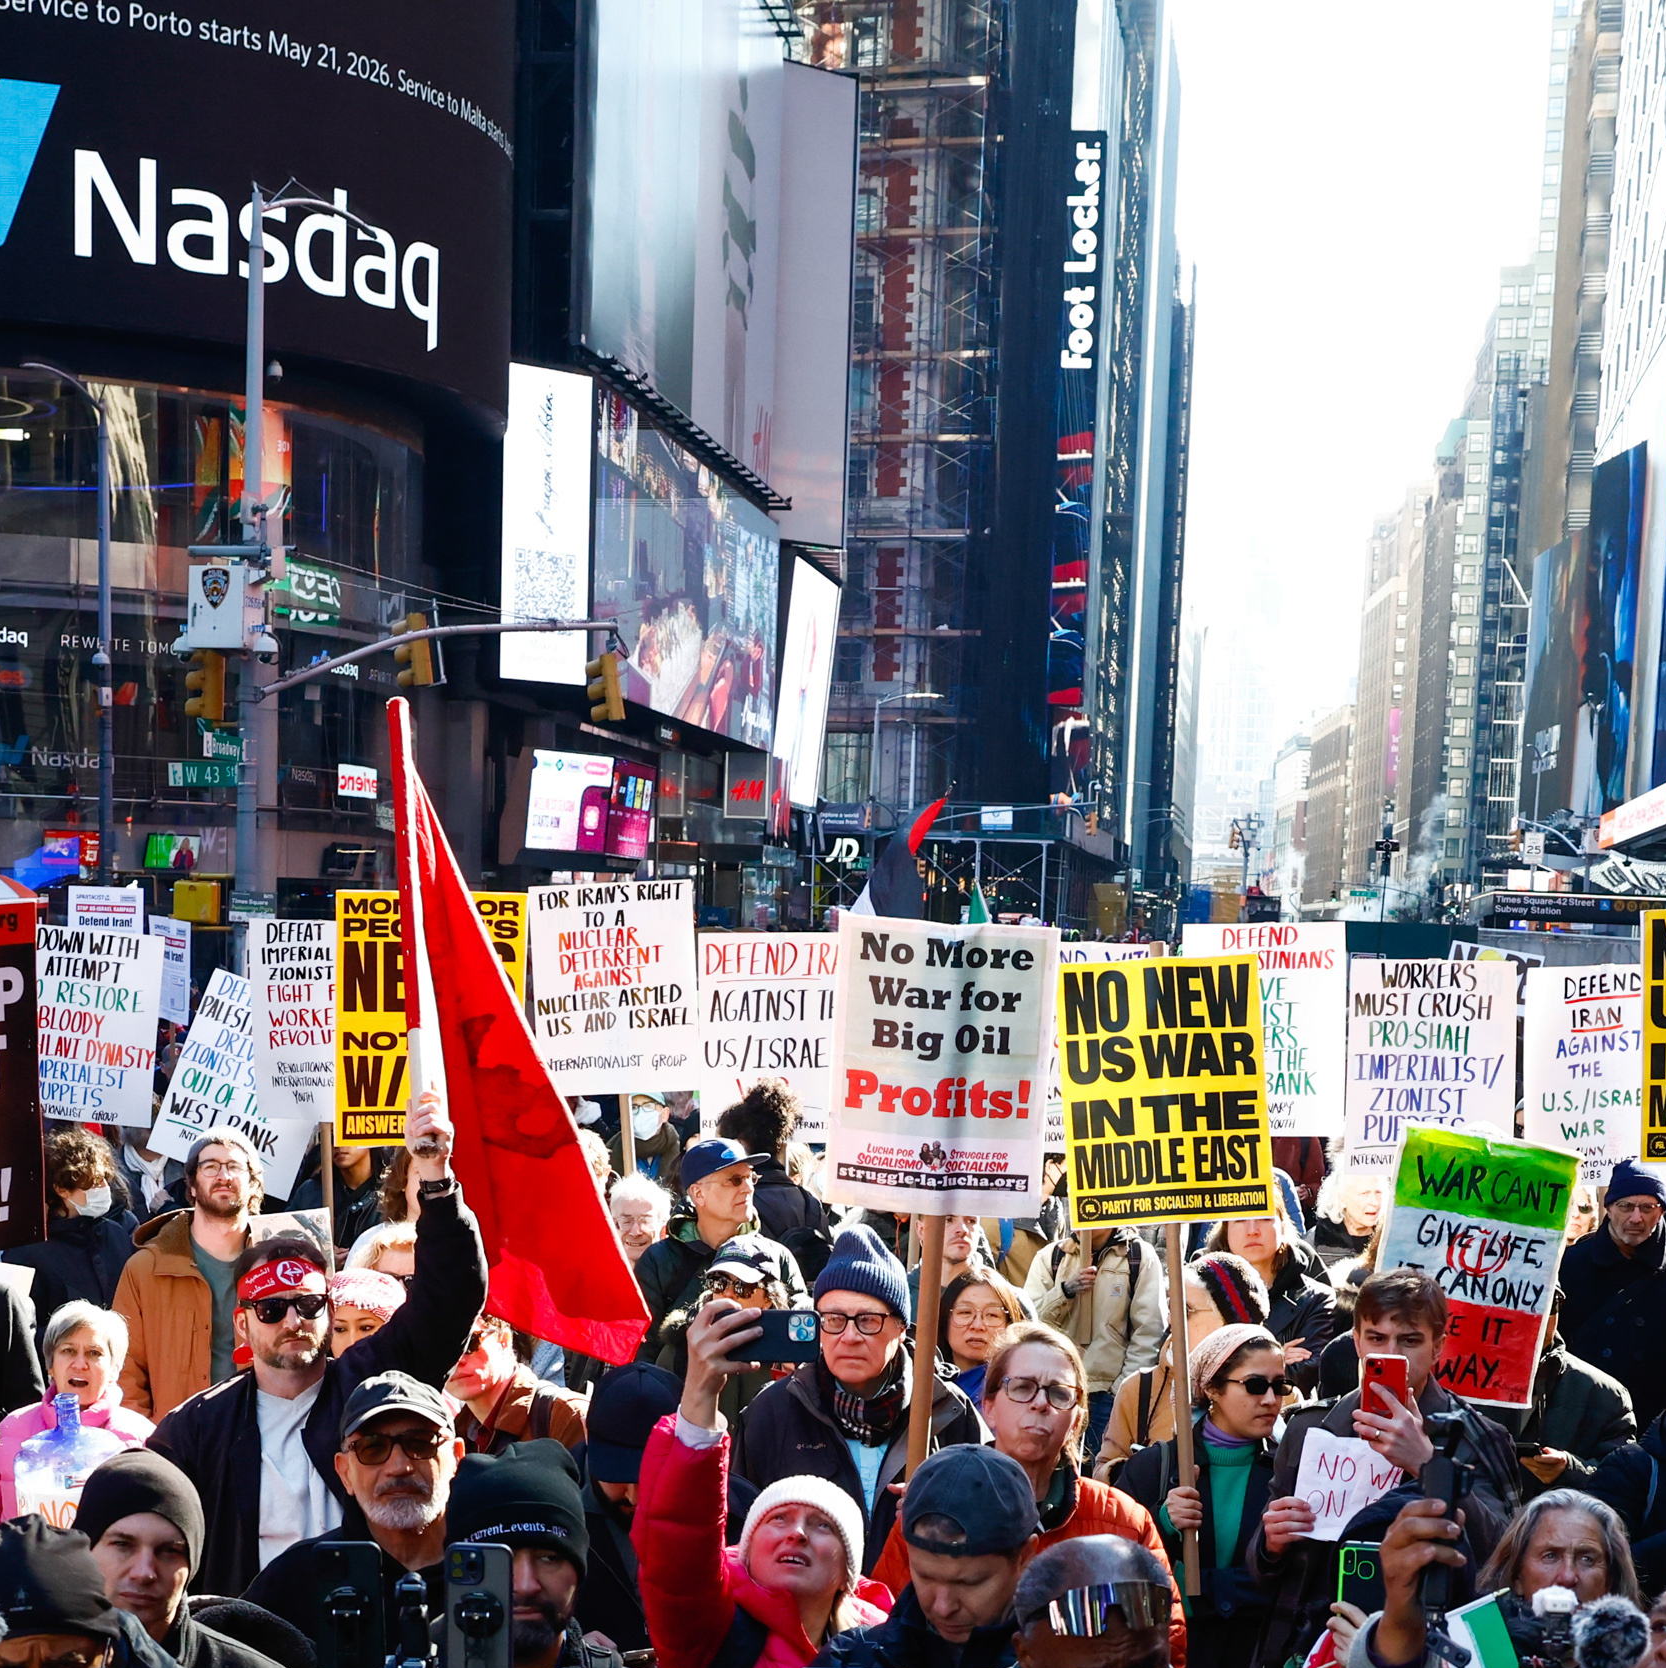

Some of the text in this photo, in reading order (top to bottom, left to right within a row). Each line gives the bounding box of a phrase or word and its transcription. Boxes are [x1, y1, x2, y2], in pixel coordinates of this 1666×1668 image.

[97, 5, 120, 24] to
[130, 4, 192, 37] Porto
[199, 17, 261, 51] starts
[269, 31, 311, 69] May
[318, 43, 342, 74] 21,
[347, 53, 393, 88] 2026.
[397, 69, 444, 109] Service
[447, 91, 458, 116] to
[461, 99, 486, 131] Malta
[74, 149, 439, 352] Nasdaq
[1061, 286, 1095, 369] Foot
[212, 733, 241, 757] Broadway
[186, 765, 197, 784] W
[205, 765, 220, 784] 43
[825, 837, 859, 863] JD
[539, 881, 685, 911] FOR IRAN'S RIGHT
[1496, 895, 1521, 904] Times
[1569, 898, 1595, 907] Street
[79, 916, 132, 927] Defend Iran!
[583, 908, 626, 928] TO A
[1495, 905, 1561, 916] Subway Station
[266, 922, 324, 944] DEFEAT
[558, 926, 640, 951] NUCLEAR
[560, 944, 664, 975] DETERRENT
[705, 941, 798, 976] DEFEND
[859, 932, 1034, 971] No More
[573, 967, 644, 992] AGAINST
[1381, 963, 1478, 991] WORKERS
[56, 982, 144, 1014] RESTORE
[267, 984, 313, 1003] FIGHT
[869, 975, 1022, 1014] War for
[1063, 963, 1250, 1036] NO NEW
[1355, 993, 1493, 1021] MUST CRUSH
[872, 1019, 1010, 1061] Big Oil
[85, 1039, 155, 1072] DYNASTY
[651, 1053, 688, 1070] GROUP
[1568, 1061, 1604, 1079] THE
[292, 1089, 315, 1104] YOUTH
[845, 1068, 1031, 1120] Profits!
[1072, 1089, 1261, 1140] IN THE
[1560, 1119, 1605, 1139] WAR
[857, 1152, 923, 1170] SOCIALISMO
[945, 1160, 1009, 1173] SOCIALISM
[949, 1149, 1008, 1160] STRUGGLE FOR
[1075, 1134, 1261, 1190] MIDDLE EAST
[839, 1165, 1028, 1190] struggle-la-lucha.org
[1102, 1191, 1265, 1214] PARTY FOR SOCIALISM & LIBERATION
